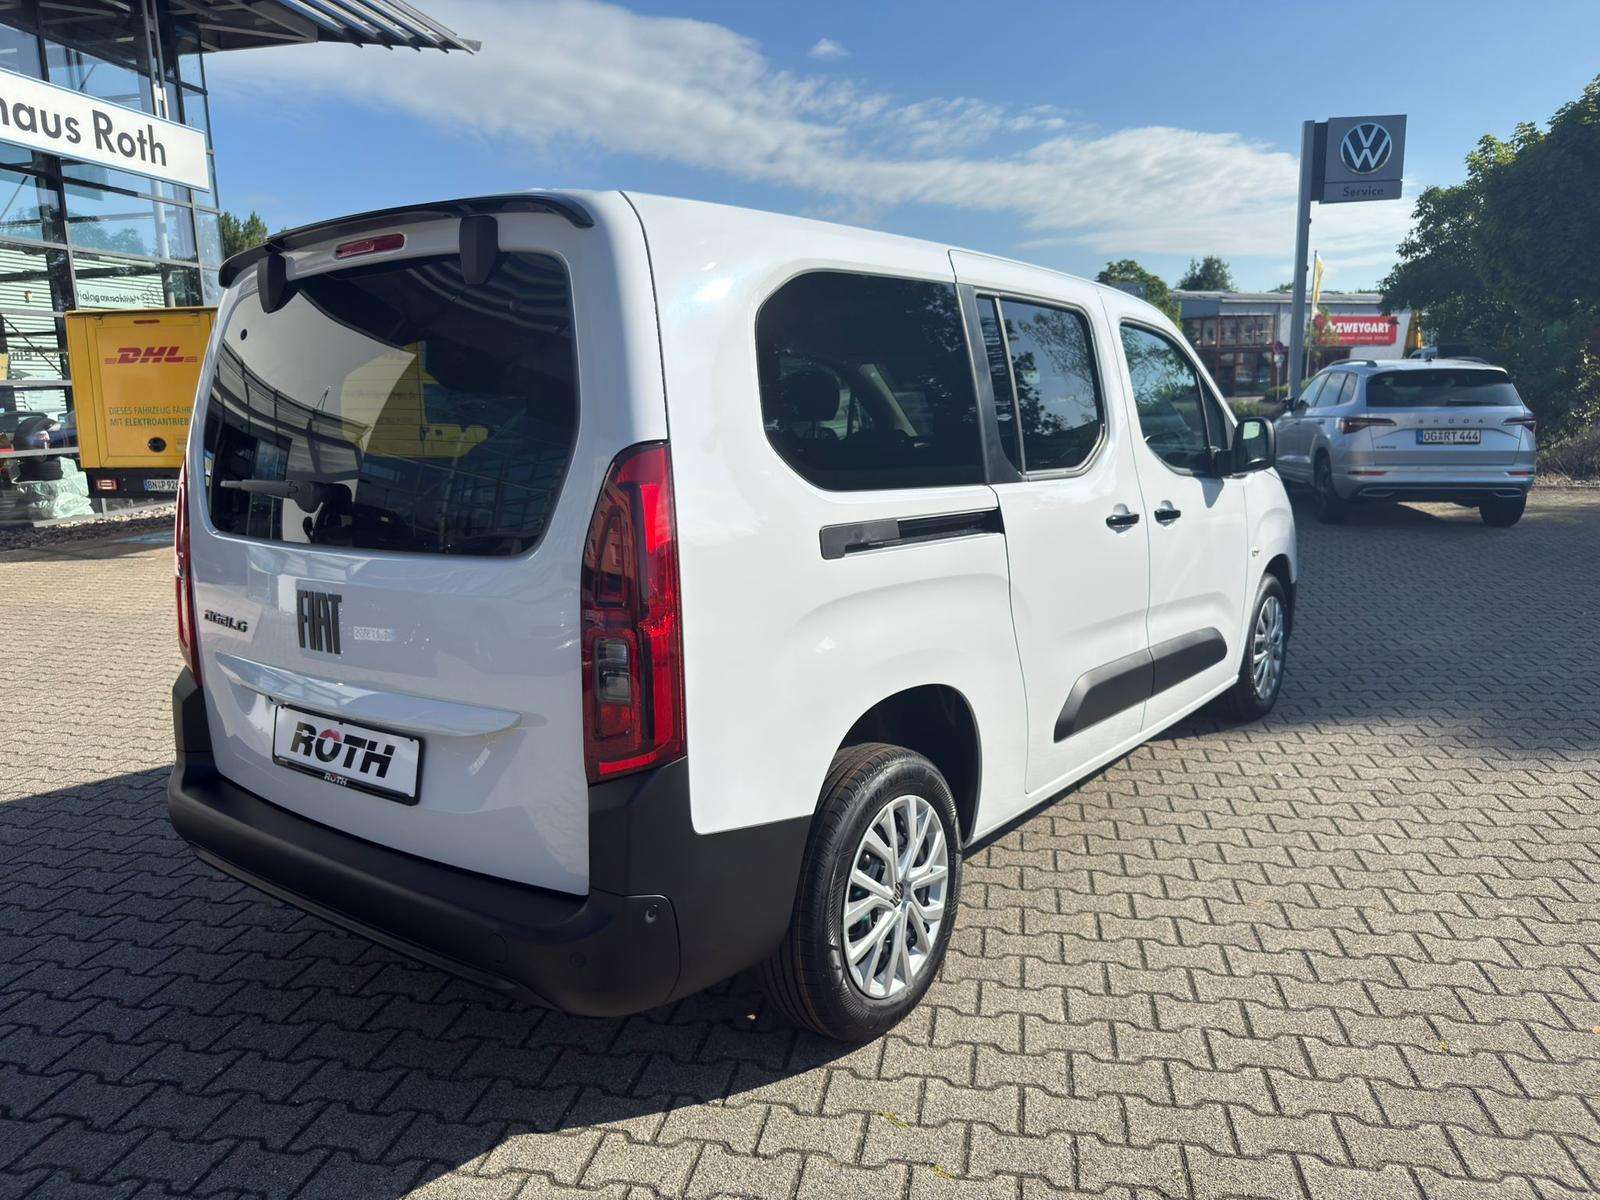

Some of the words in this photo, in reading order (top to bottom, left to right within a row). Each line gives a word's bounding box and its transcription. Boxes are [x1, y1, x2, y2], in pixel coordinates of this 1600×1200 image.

[92, 109, 167, 167] Roth
[1343, 186, 1384, 197] Service
[1336, 322, 1391, 334] ZWEYGART
[116, 345, 185, 365] DHL
[109, 406, 132, 415] DIESES
[133, 405, 172, 415] FAHRZEUG
[1459, 431, 1478, 441] 444
[296, 589, 343, 655] FIAT
[290, 721, 395, 779] ROTH
[324, 772, 348, 786] ROTH
